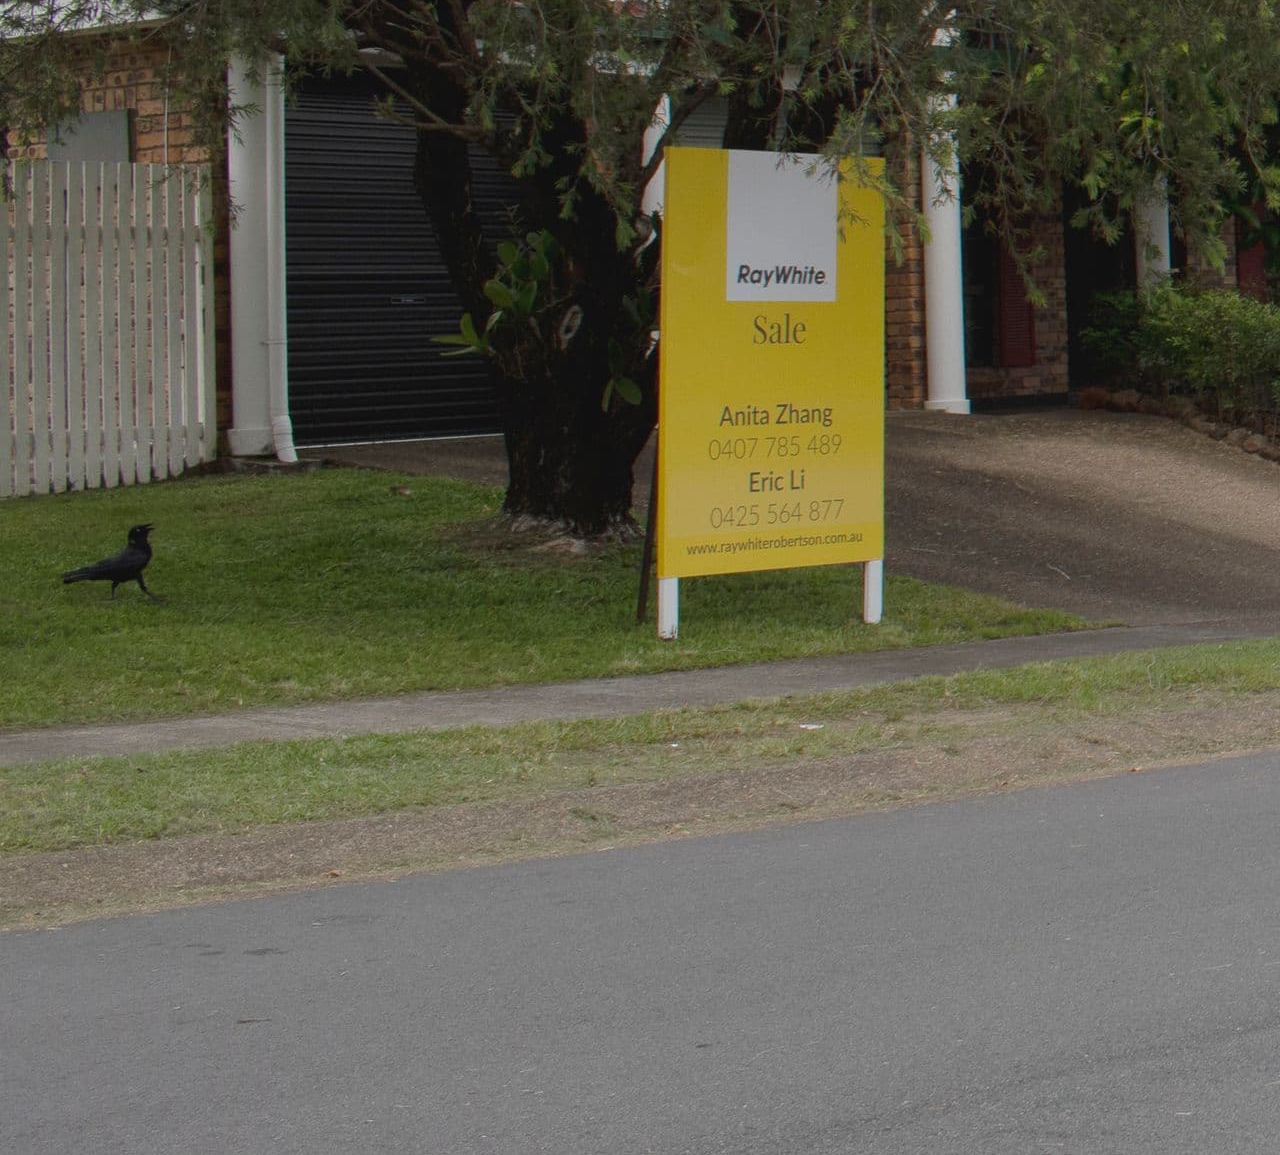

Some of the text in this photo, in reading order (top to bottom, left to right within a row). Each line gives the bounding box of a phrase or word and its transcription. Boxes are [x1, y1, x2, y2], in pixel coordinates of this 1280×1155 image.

[753, 313, 807, 345] Sale
[719, 404, 833, 427] Anita Zhang
[708, 433, 842, 461] 0407 785 489
[749, 469, 805, 493] Eric Li
[710, 499, 844, 529] 0425 564 877
[687, 532, 863, 556] www.raywhiterobertson.com.au
